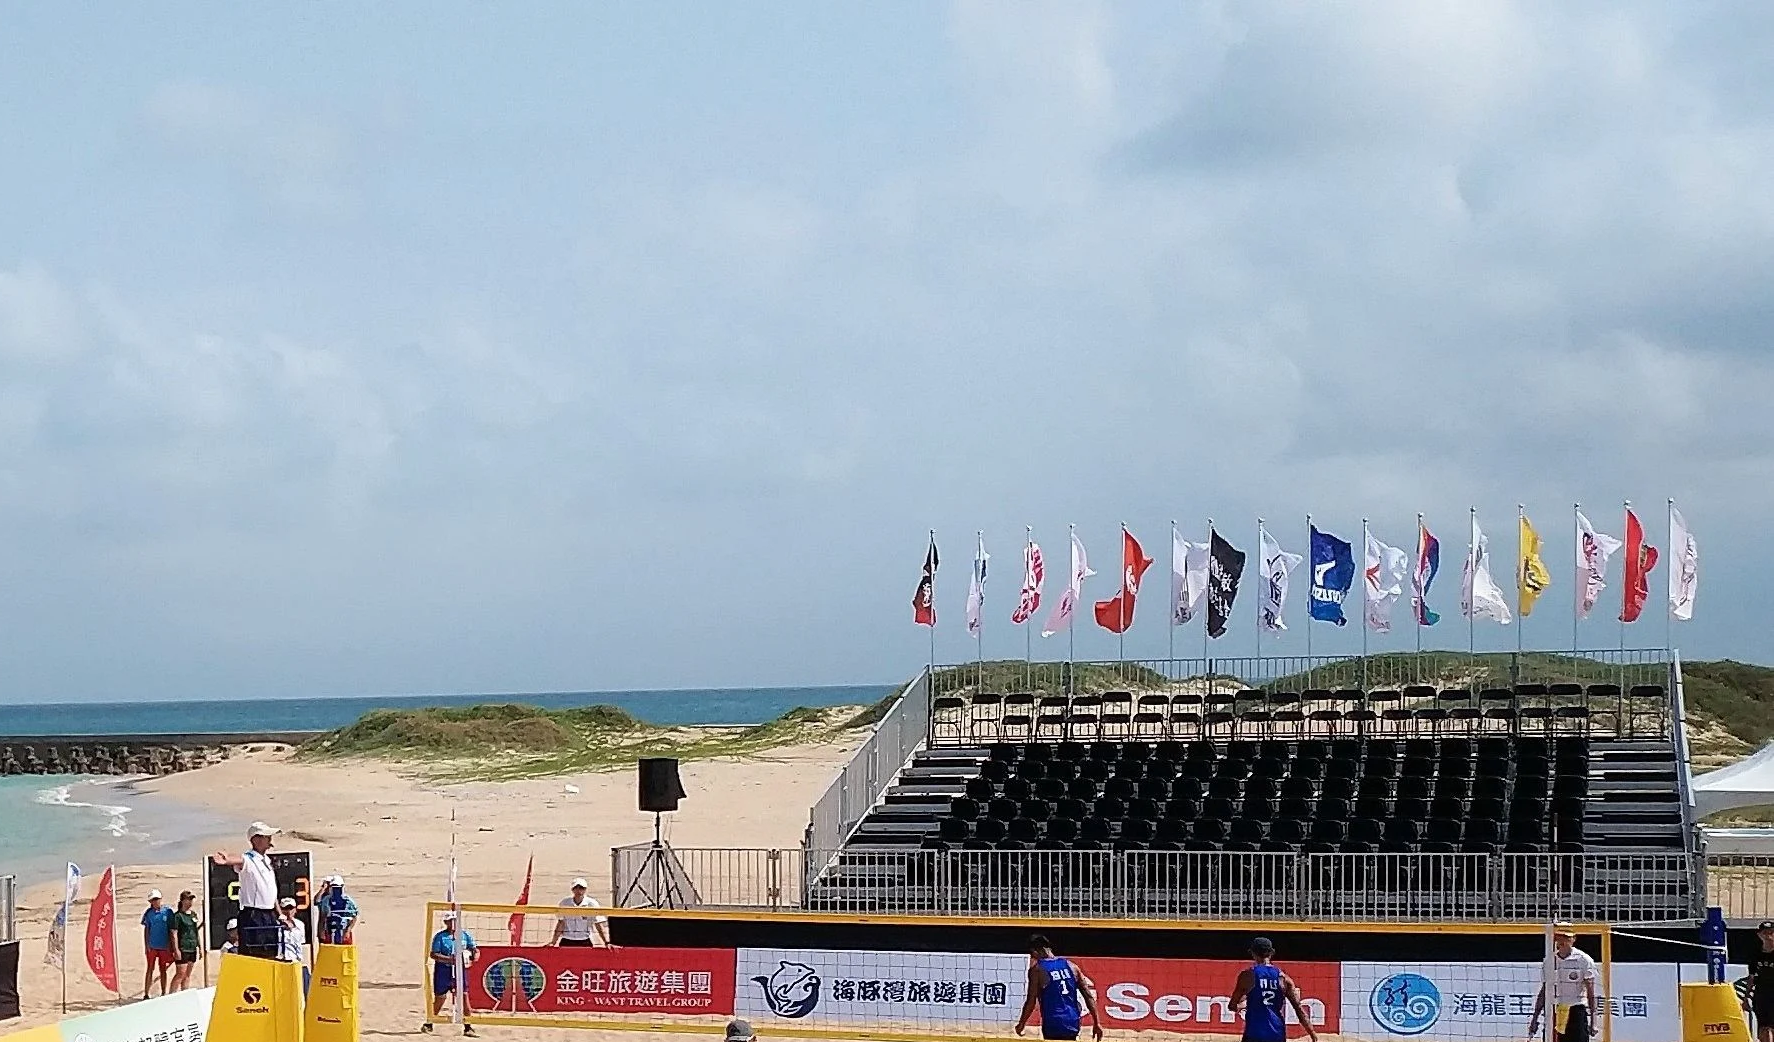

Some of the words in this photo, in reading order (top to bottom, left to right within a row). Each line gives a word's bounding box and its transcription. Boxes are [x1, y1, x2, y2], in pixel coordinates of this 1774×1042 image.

[295, 877, 309, 910] 3
[556, 969, 712, 995] 金旺旅遊集團
[557, 996, 584, 1005] KING
[594, 996, 626, 1006] WANT
[628, 998, 670, 1007] TRAVEL
[672, 998, 711, 1007] GROUP
[1105, 982, 1325, 1026] Senh
